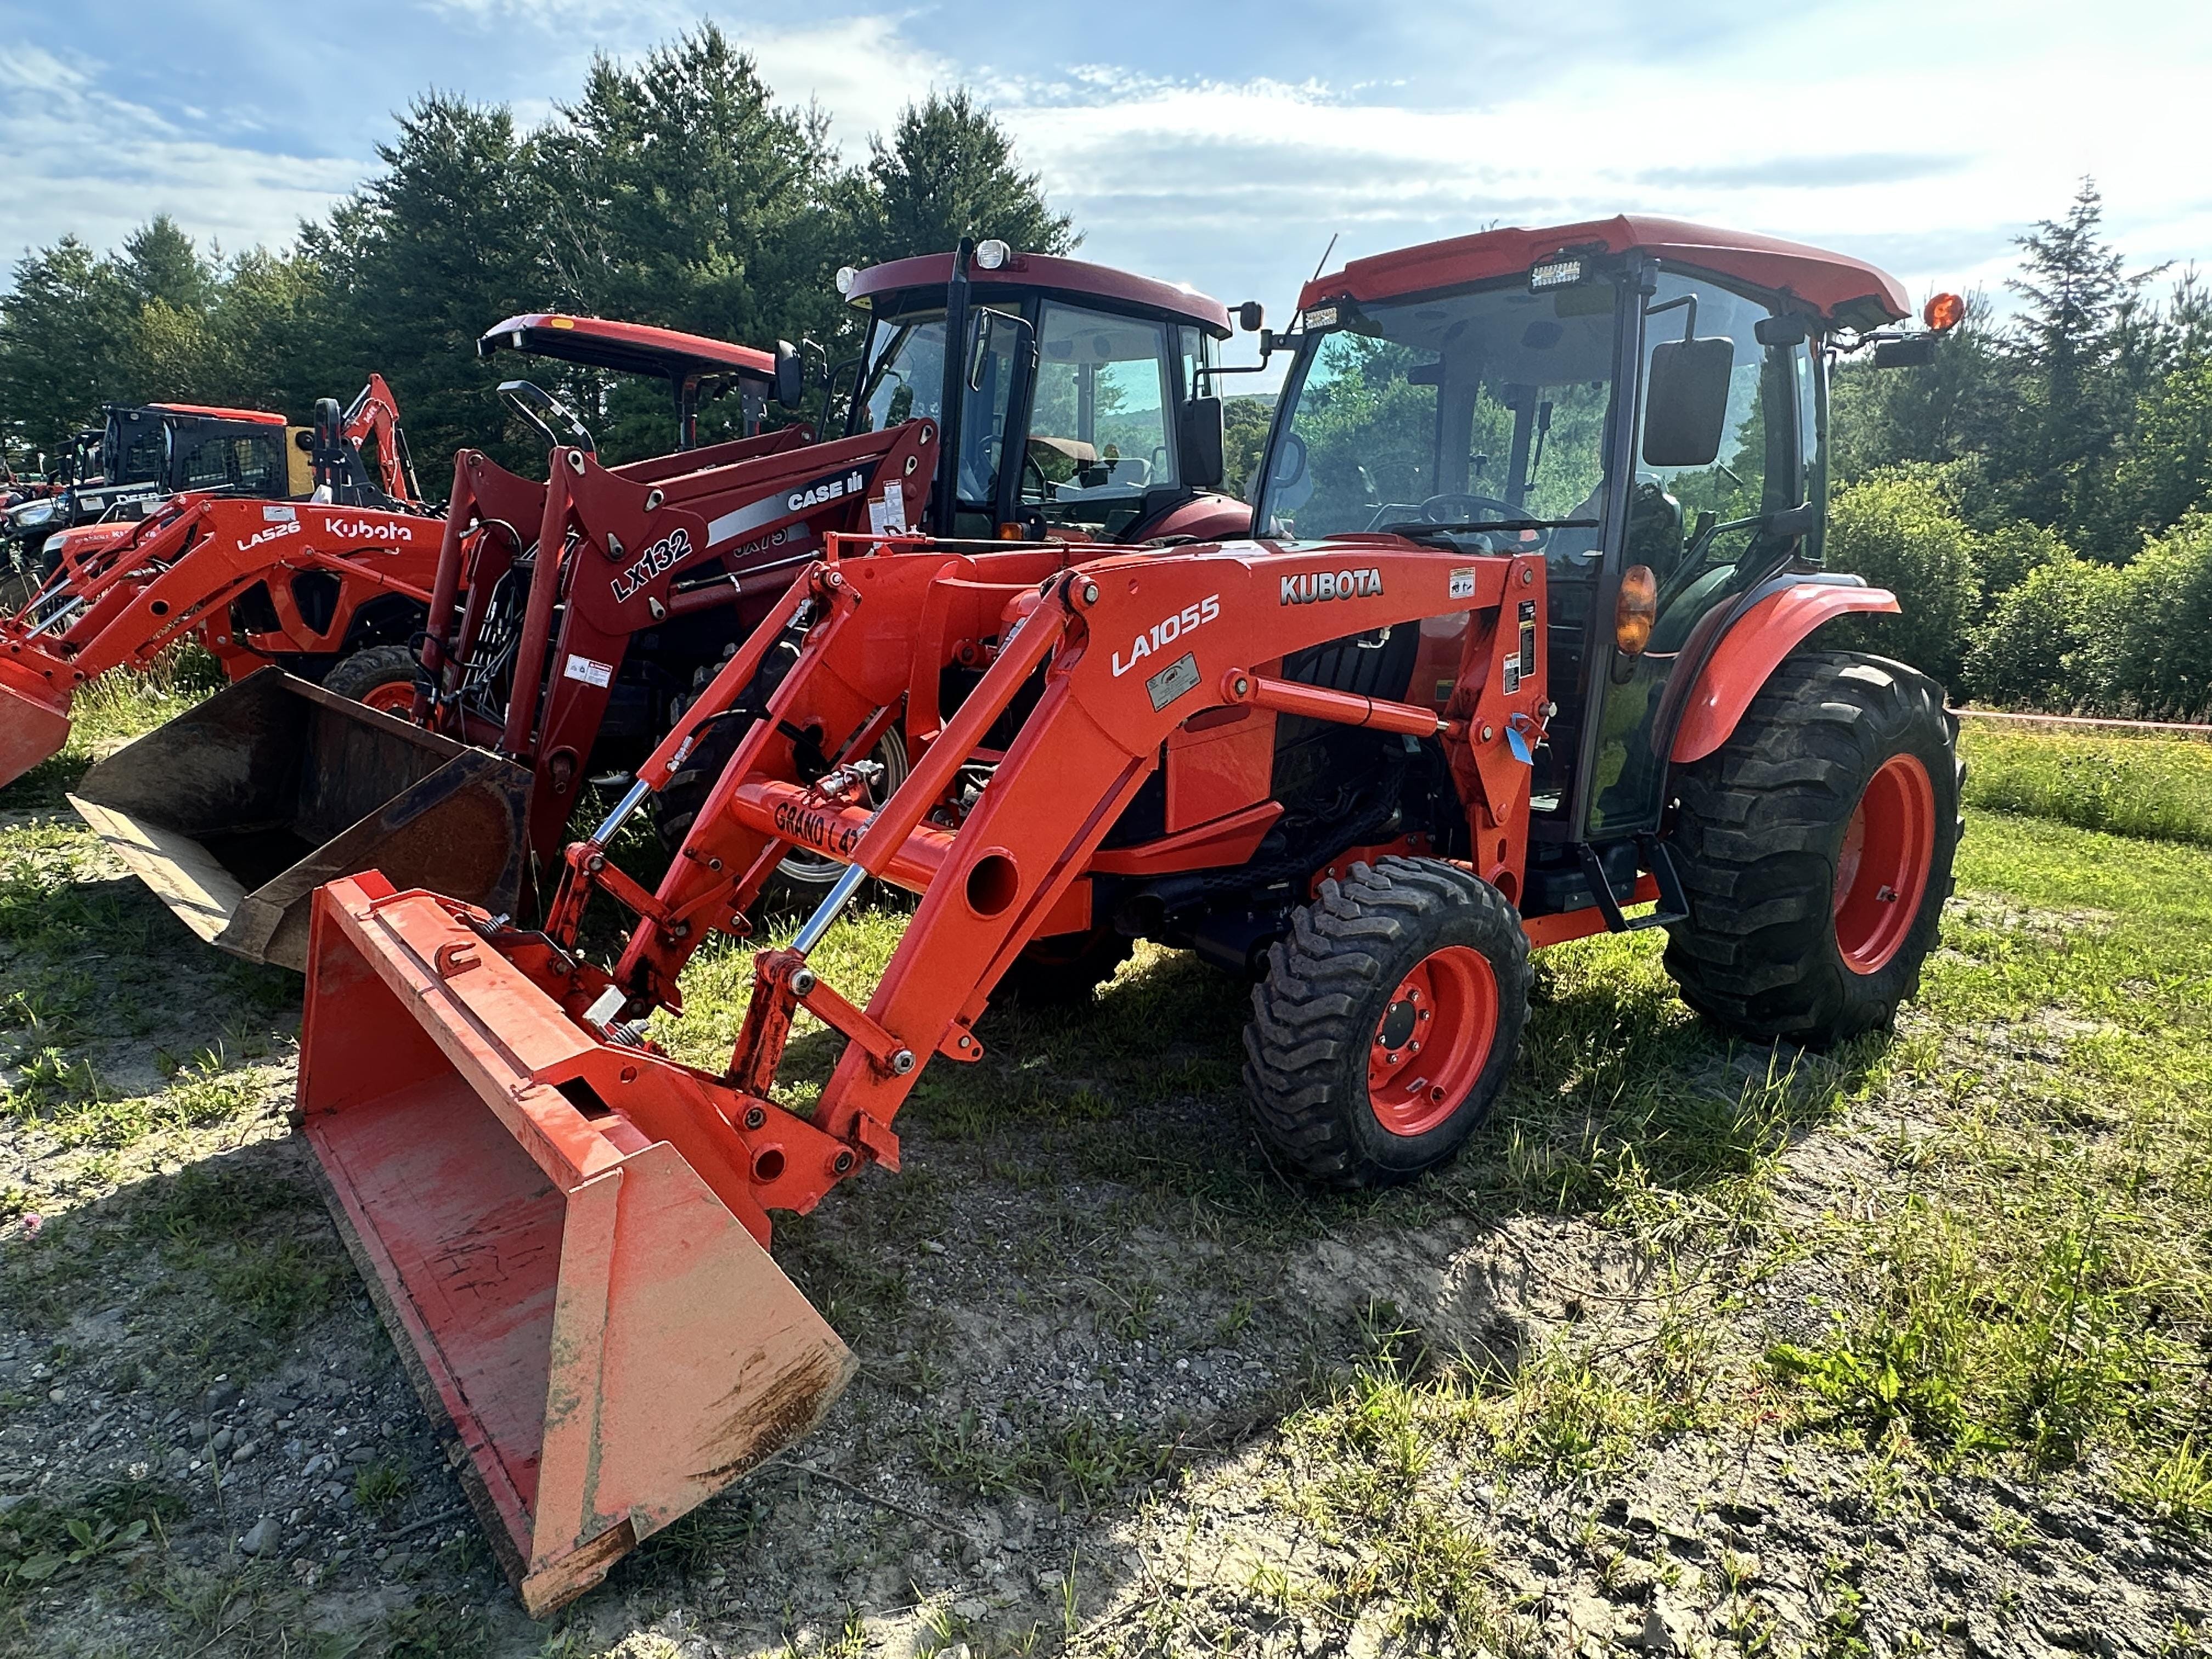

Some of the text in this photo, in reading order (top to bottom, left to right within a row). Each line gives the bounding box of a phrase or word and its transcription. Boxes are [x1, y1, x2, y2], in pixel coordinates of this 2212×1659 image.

[788, 481, 843, 511] CASE
[237, 521, 301, 551] LA526
[325, 518, 412, 541] Kubota
[610, 528, 692, 603] LX132
[1280, 567, 1384, 606] KUBOTA
[1111, 593, 1220, 677] LA1055
